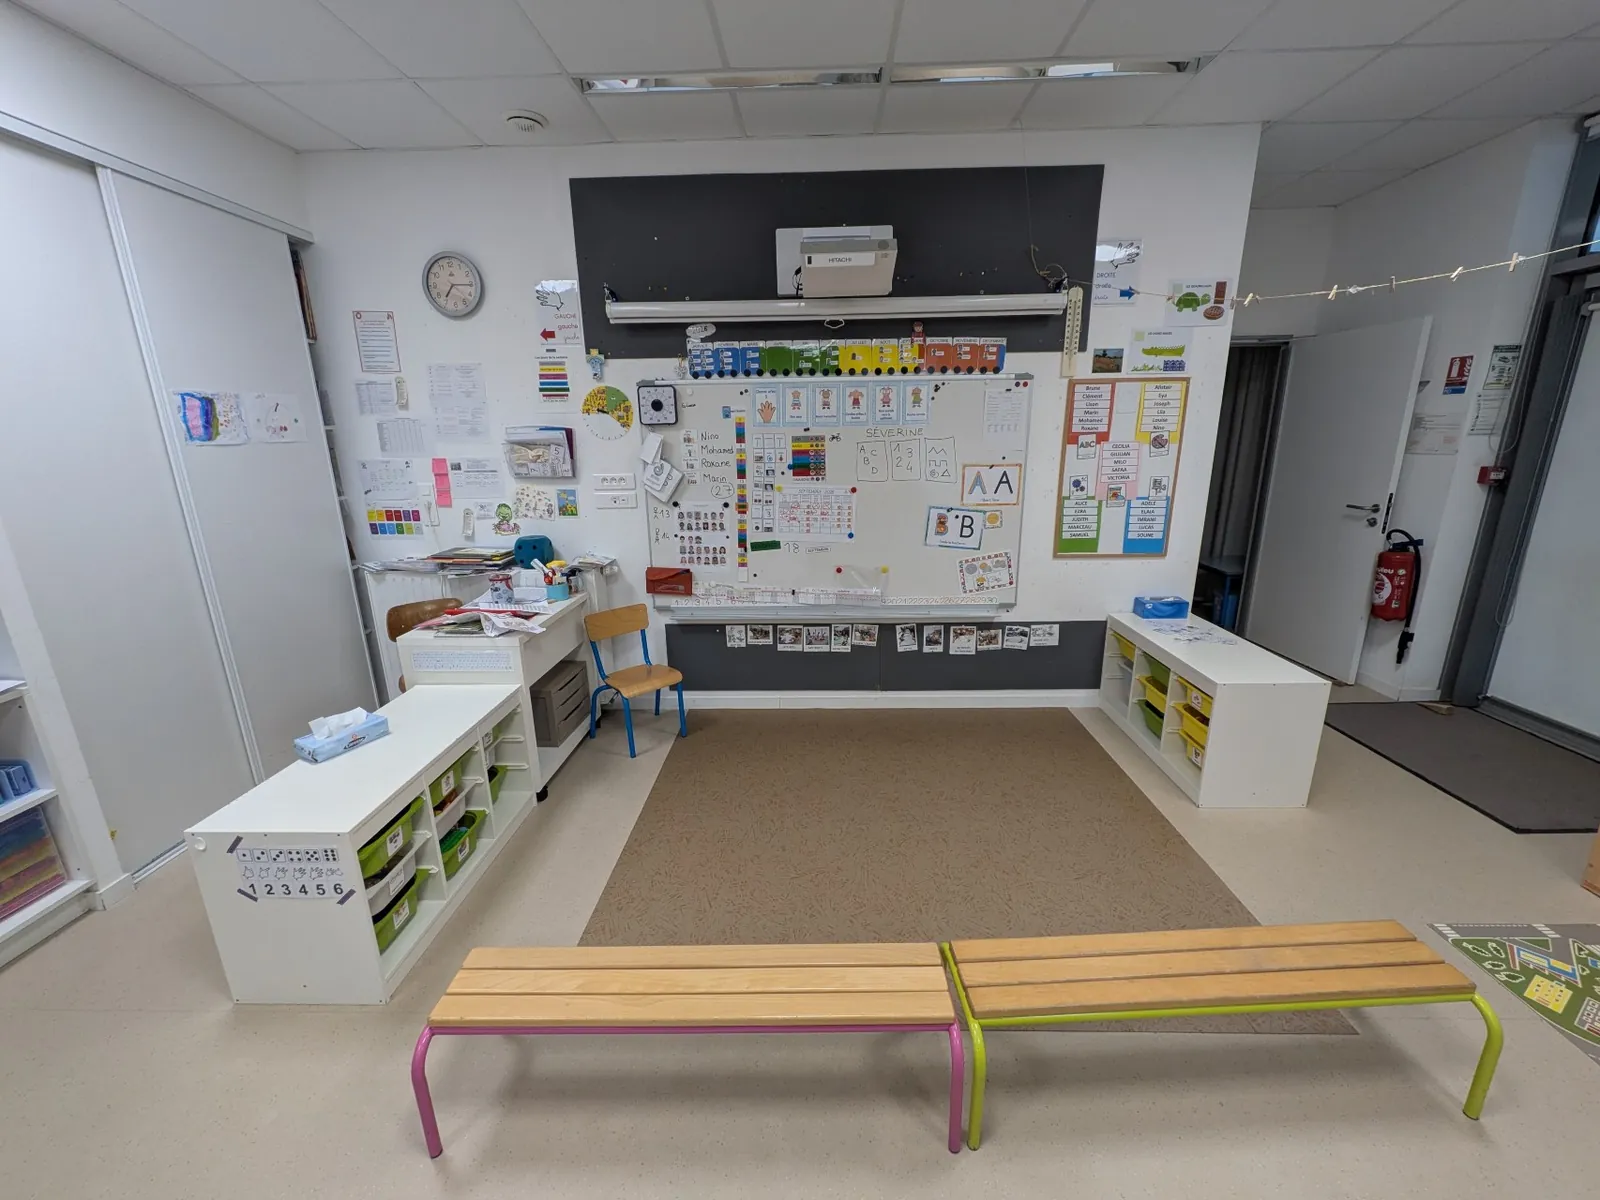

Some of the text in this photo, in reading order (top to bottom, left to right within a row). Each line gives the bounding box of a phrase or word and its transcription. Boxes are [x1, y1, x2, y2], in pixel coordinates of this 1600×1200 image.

[701, 431, 719, 441] Nino
[866, 426, 924, 438] SÉVERINE
[554, 447, 560, 455] 5
[700, 444, 734, 455] Mohamed
[859, 445, 866, 454] A
[894, 443, 900, 452] 1
[906, 448, 913, 458] 3
[701, 458, 731, 468] Roxane
[863, 456, 870, 465] B
[896, 456, 903, 468] 2
[871, 466, 878, 474] D
[906, 461, 913, 473] 4
[703, 474, 726, 482] Marin
[968, 470, 1013, 494] A A
[715, 485, 732, 495] 27
[659, 509, 671, 518] 13
[934, 512, 974, 538] B B
[784, 542, 800, 554] 18
[249, 884, 344, 895] 1 2 3 4 5 6
